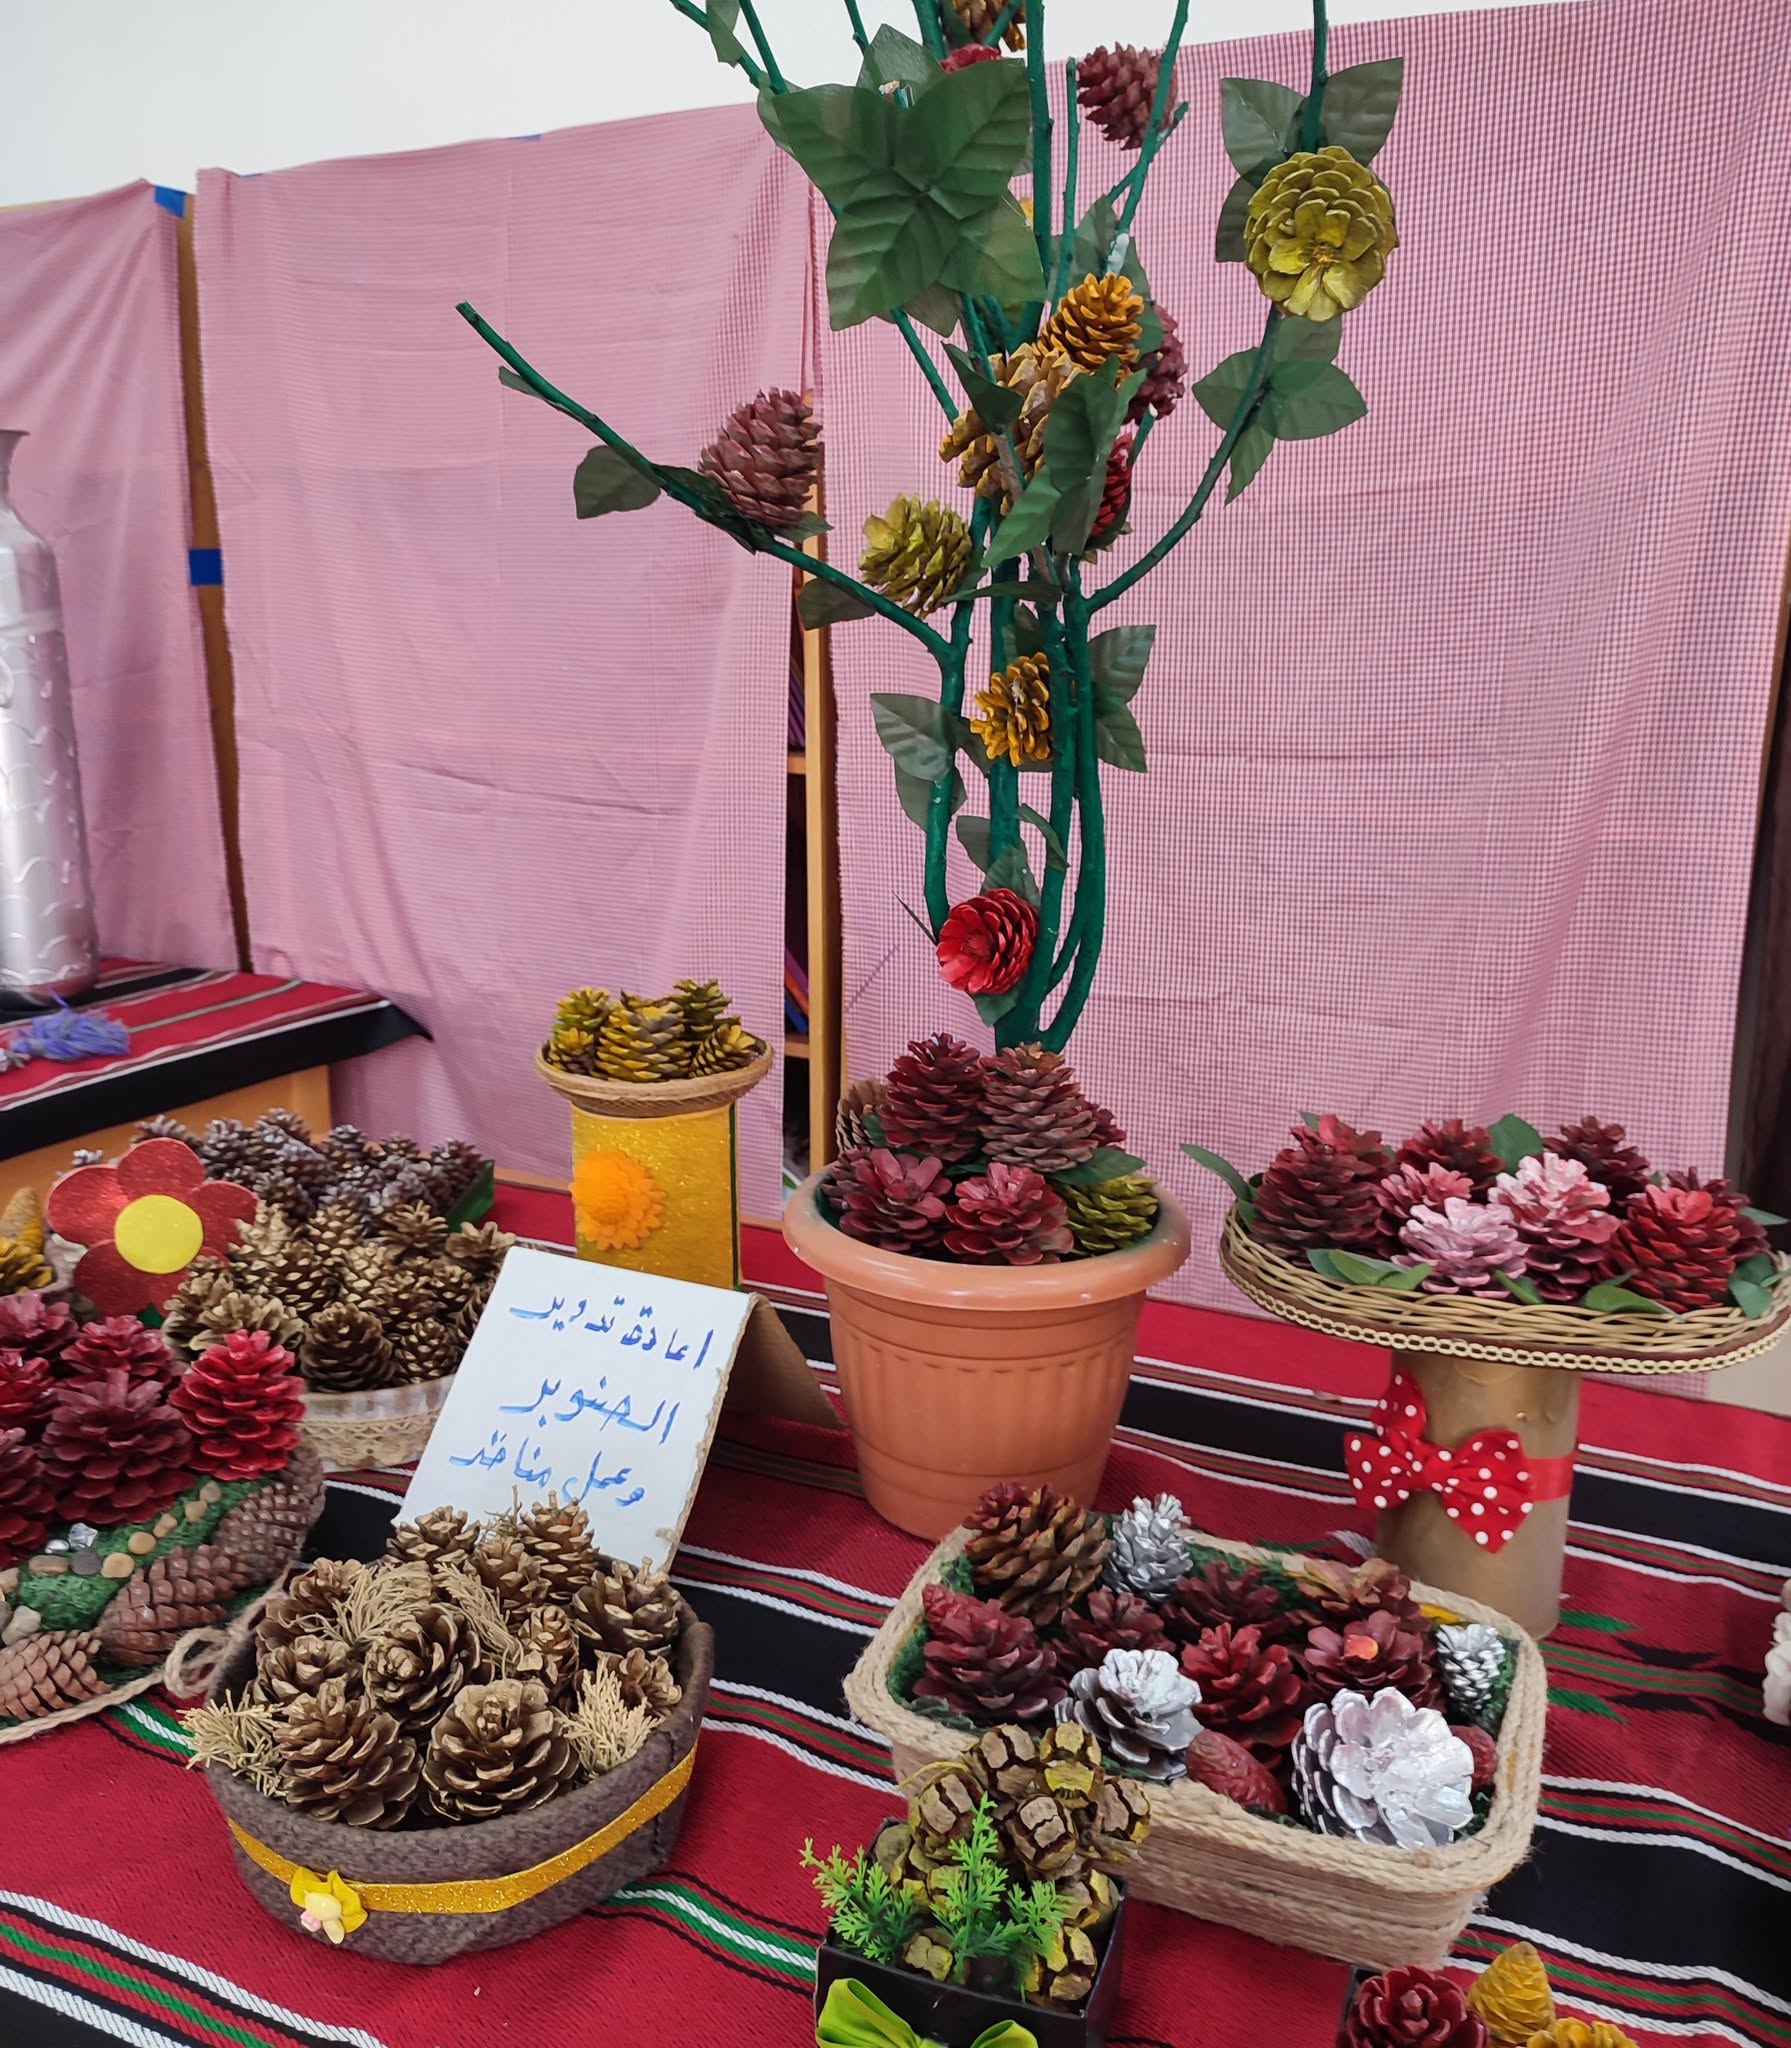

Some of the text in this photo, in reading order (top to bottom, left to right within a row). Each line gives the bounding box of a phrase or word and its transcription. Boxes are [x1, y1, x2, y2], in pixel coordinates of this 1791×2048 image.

[510, 1295, 715, 1369] اعادة تدوير
[499, 1375, 681, 1444] الصنوبر
[560, 1450, 646, 1508] وعمل
